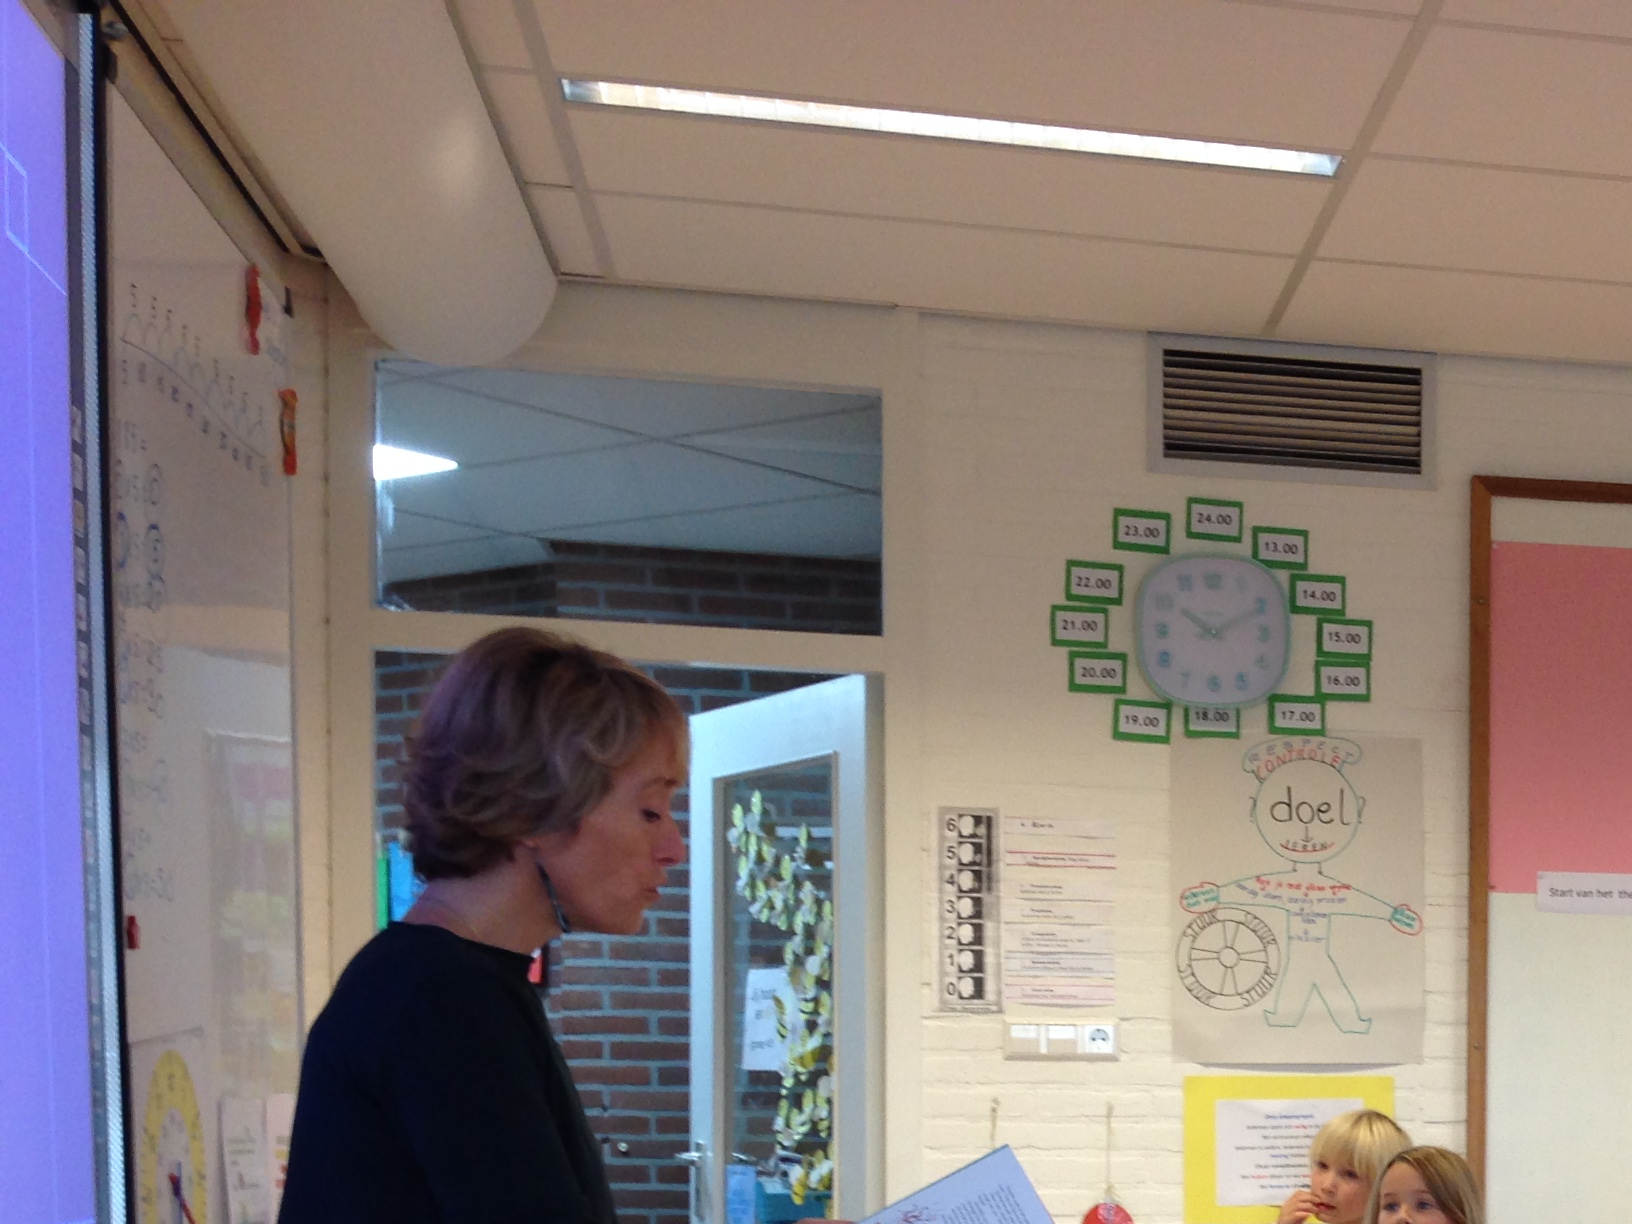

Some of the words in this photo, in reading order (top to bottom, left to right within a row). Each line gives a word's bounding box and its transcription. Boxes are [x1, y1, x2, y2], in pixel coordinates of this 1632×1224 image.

[1196, 511, 1233, 527] 24.00
[1123, 524, 1161, 540] 23.00
[1263, 541, 1299, 556] 13.00
[1075, 575, 1112, 590] 22.00
[1302, 589, 1337, 603] 14.00
[1061, 619, 1098, 633] 21.00
[1327, 631, 1362, 645] 15.00
[1080, 666, 1117, 680] 20.00
[1325, 674, 1361, 688] 16.00
[1123, 714, 1160, 728] 19.00
[1194, 709, 1230, 723] 18.00
[1280, 709, 1315, 723] 17.00
[1269, 785, 1351, 826] doel
[946, 818, 956, 832] 6
[946, 845, 956, 860] 5
[946, 872, 956, 887] 4
[1548, 887, 1574, 898] Start
[1576, 890, 1595, 898] van
[1596, 888, 1614, 899] het
[946, 899, 956, 914] 3
[946, 926, 956, 940] 2
[948, 954, 955, 966] 1
[946, 982, 956, 997] 0
